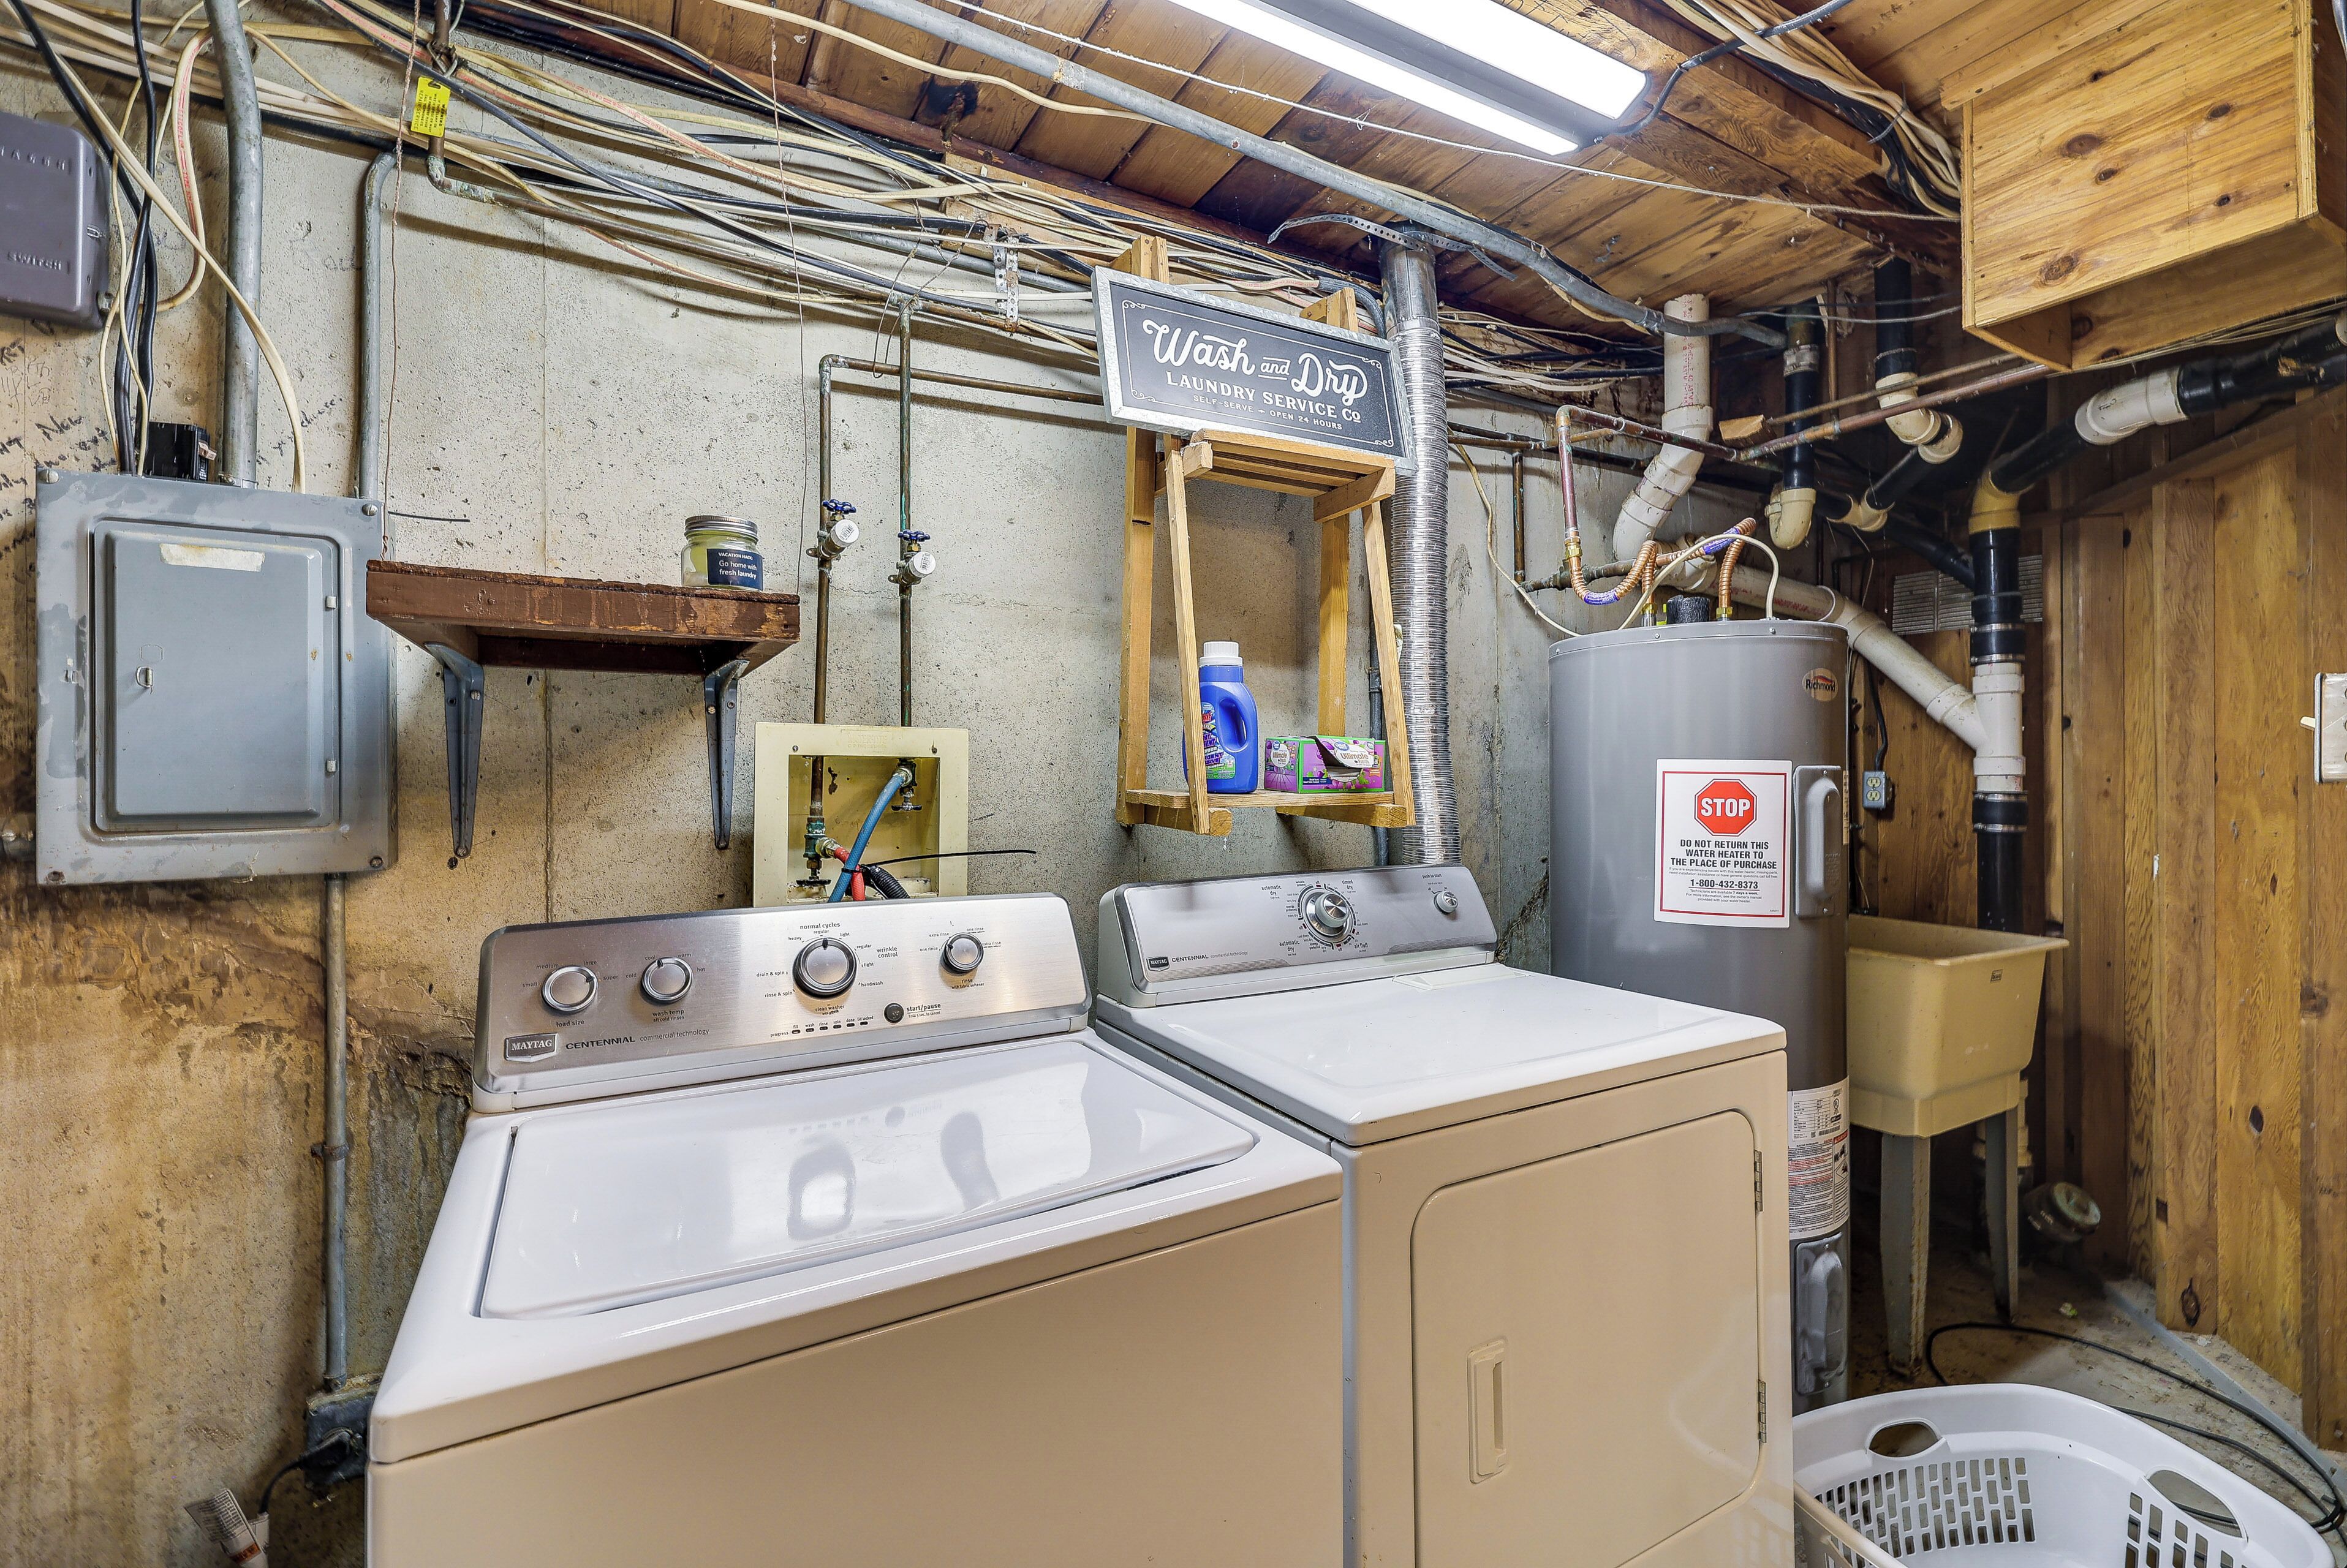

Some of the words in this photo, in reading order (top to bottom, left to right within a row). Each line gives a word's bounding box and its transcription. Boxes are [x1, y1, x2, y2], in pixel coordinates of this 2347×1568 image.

[7, 251, 62, 270] SWITCH
[1143, 319, 1256, 375] Wash
[1259, 357, 1291, 377] and
[1291, 352, 1367, 406] Dry
[1165, 371, 1256, 402] LAUNDRY
[1262, 391, 1338, 418] SERVICE
[1193, 394, 1254, 413] SELF-SERVE
[1269, 410, 1294, 421] OPEN
[1313, 418, 1343, 430] HOURS
[738, 570, 757, 580] laundry
[1805, 678, 1835, 692] Richmond
[1701, 797, 1750, 817] STOP
[1695, 840, 1712, 848] NOT
[1714, 840, 1748, 849] RETURN
[1685, 849, 1715, 858] WATER
[1718, 850, 1750, 859] HEATER
[1753, 851, 1764, 859] TO
[1671, 858, 1687, 866] THE
[1690, 859, 1717, 867] PLACE
[1734, 861, 1777, 869] PURCHASE
[1690, 879, 1758, 889] 1-800-432-8373
[906, 1003, 942, 1012] start/pause
[511, 1039, 552, 1051] MAYTAG
[565, 1036, 635, 1050] CENTENNIAL
[640, 1031, 676, 1042] commercial
[676, 1028, 709, 1038] technology
